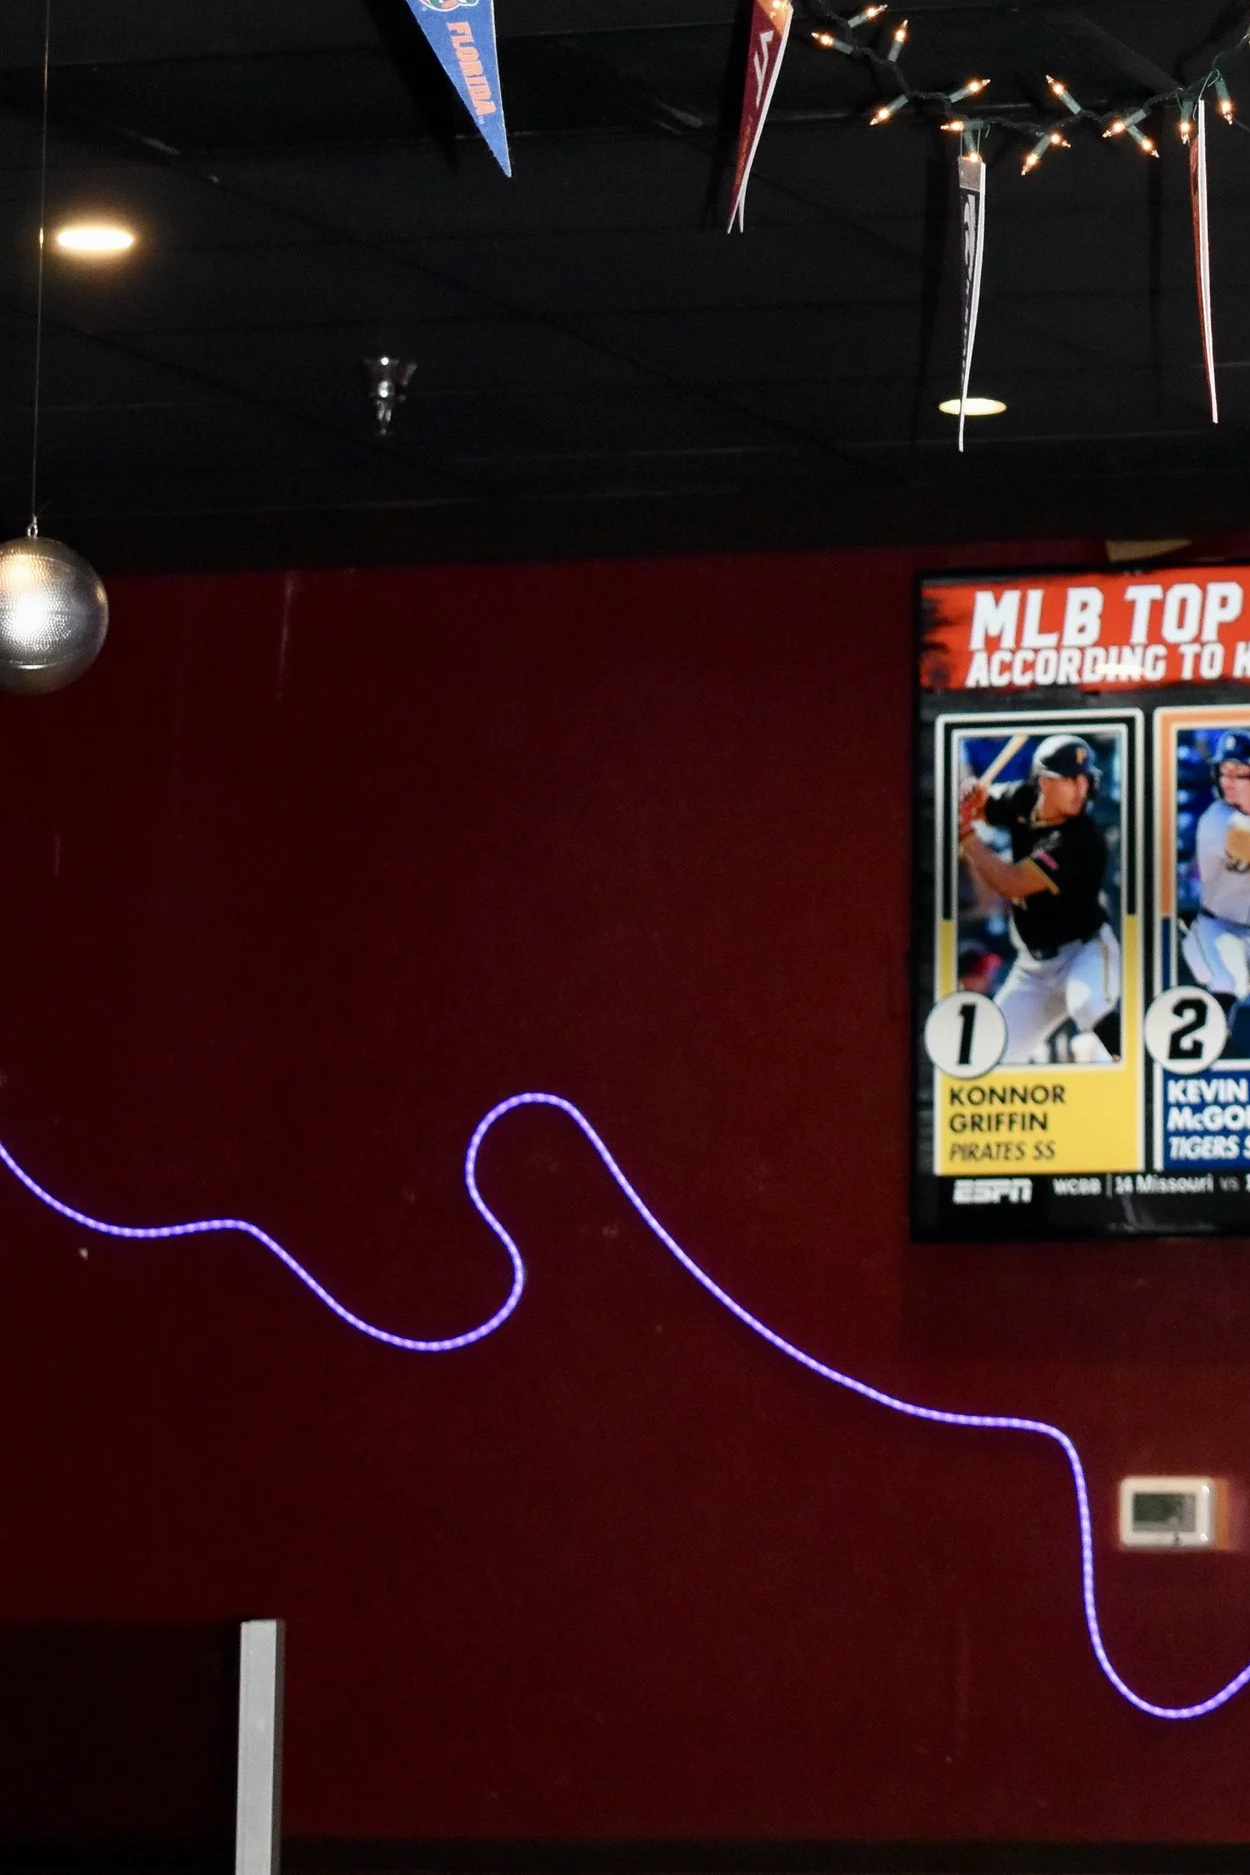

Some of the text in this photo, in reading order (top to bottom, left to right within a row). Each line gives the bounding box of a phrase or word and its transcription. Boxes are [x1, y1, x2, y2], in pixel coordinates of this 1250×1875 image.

[446, 20, 497, 117] FLORIDA
[969, 586, 1104, 650] MLB
[1124, 581, 1244, 644] TOP
[966, 644, 1169, 688] ACCORDING
[1179, 641, 1225, 680] TO
[957, 1004, 978, 1067] 1
[1167, 998, 1209, 1061] 2
[949, 1084, 1067, 1107] KONNOR
[1167, 1078, 1249, 1104] KEVIN
[949, 1112, 1049, 1134] GRIFFIN
[949, 1139, 1056, 1162] PIRATES SS
[1168, 1135, 1239, 1161] TIGERS
[952, 1177, 1033, 1205] ESPN
[1135, 1173, 1215, 1195] Missouri
[1220, 1176, 1241, 1193] vs
